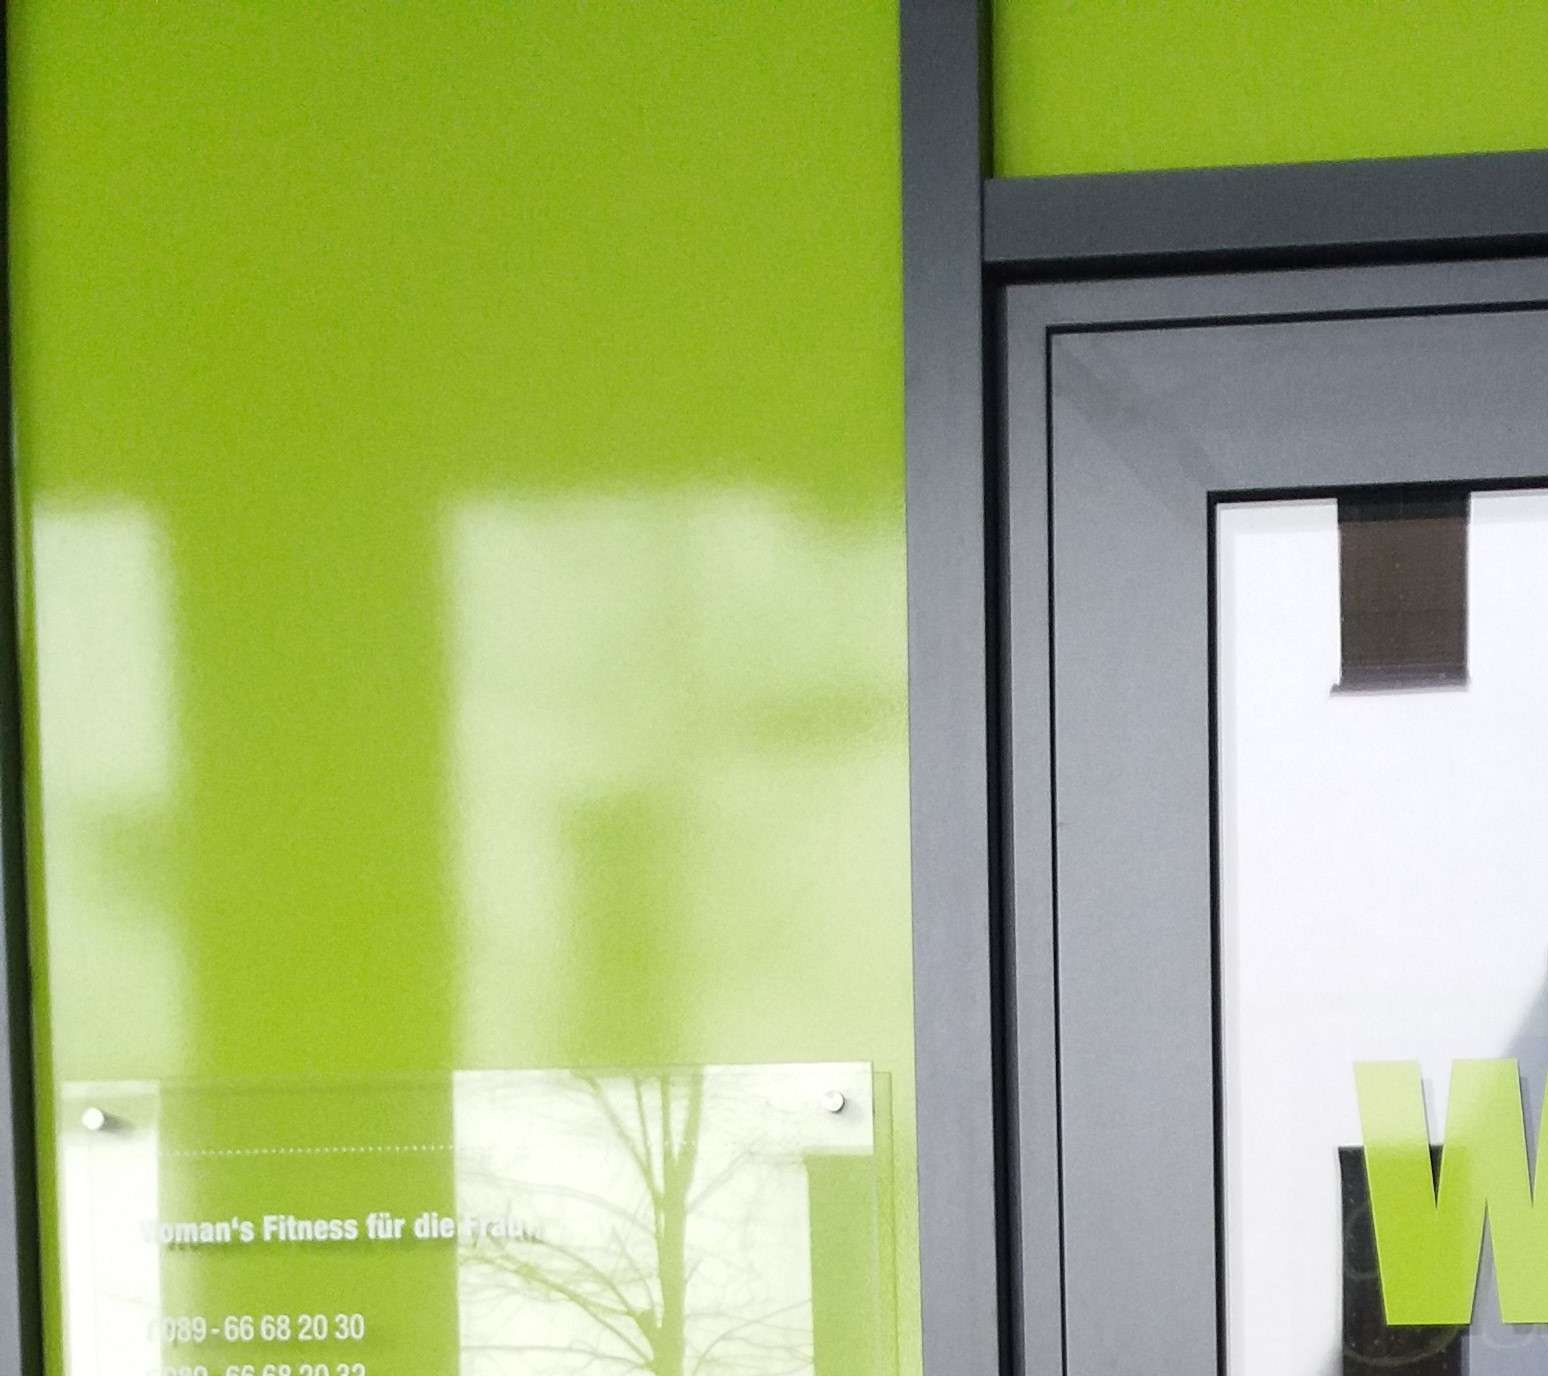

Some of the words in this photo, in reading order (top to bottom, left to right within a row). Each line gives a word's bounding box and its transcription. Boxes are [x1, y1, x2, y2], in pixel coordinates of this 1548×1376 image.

[263, 1214, 358, 1241] Fitness
[366, 1211, 405, 1240] für
[414, 1212, 455, 1239] die
[260, 1314, 291, 1341] 68
[298, 1313, 328, 1340] 20
[335, 1313, 365, 1339] 30
